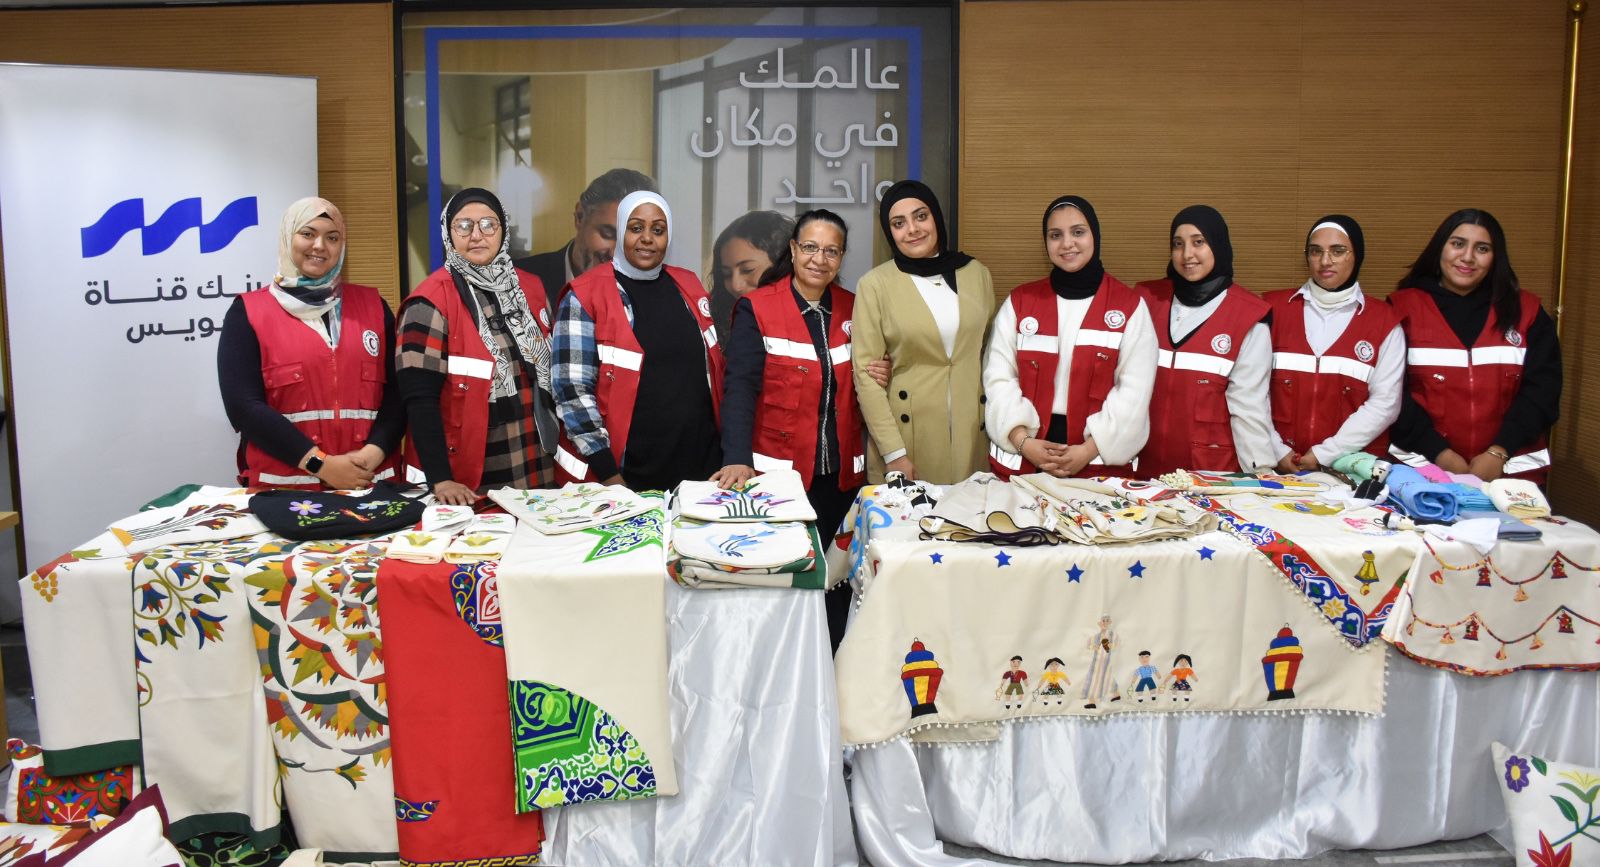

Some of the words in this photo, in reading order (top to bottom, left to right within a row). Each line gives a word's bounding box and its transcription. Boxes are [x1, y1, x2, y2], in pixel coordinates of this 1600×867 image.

[740, 47, 899, 89] عالمك
[690, 105, 797, 158] مكان
[815, 111, 898, 168] في
[84, 277, 187, 306] قناة
